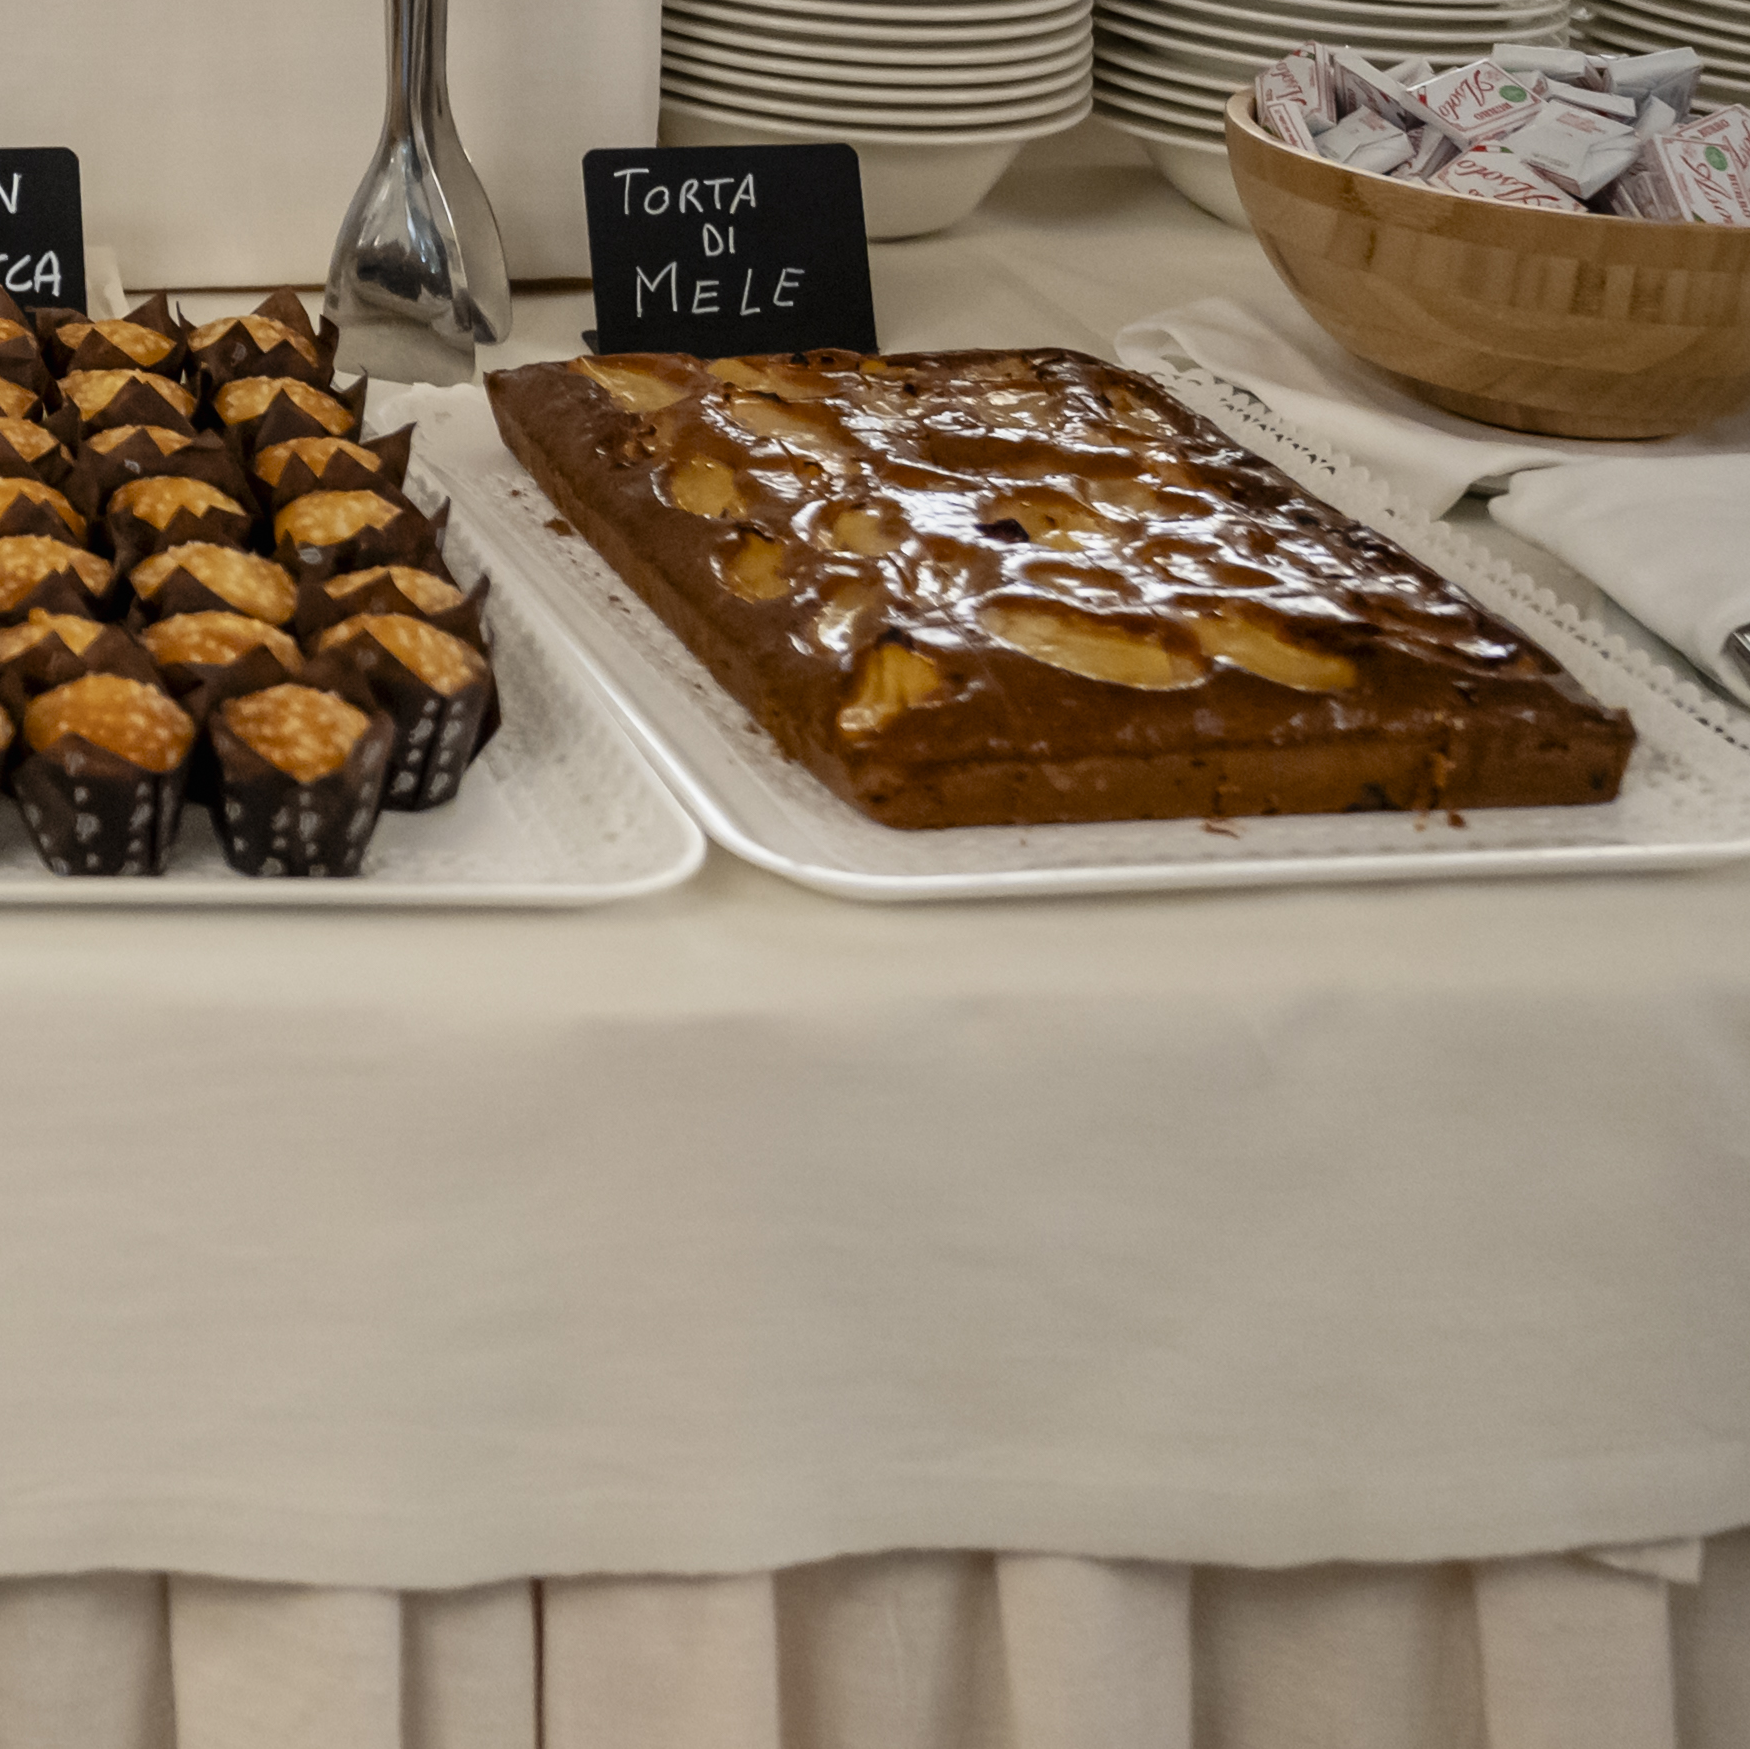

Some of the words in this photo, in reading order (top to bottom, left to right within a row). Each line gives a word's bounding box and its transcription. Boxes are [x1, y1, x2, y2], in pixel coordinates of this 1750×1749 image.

[613, 167, 757, 217] TORTA
[702, 222, 736, 256] DI
[635, 261, 806, 319] MELE
